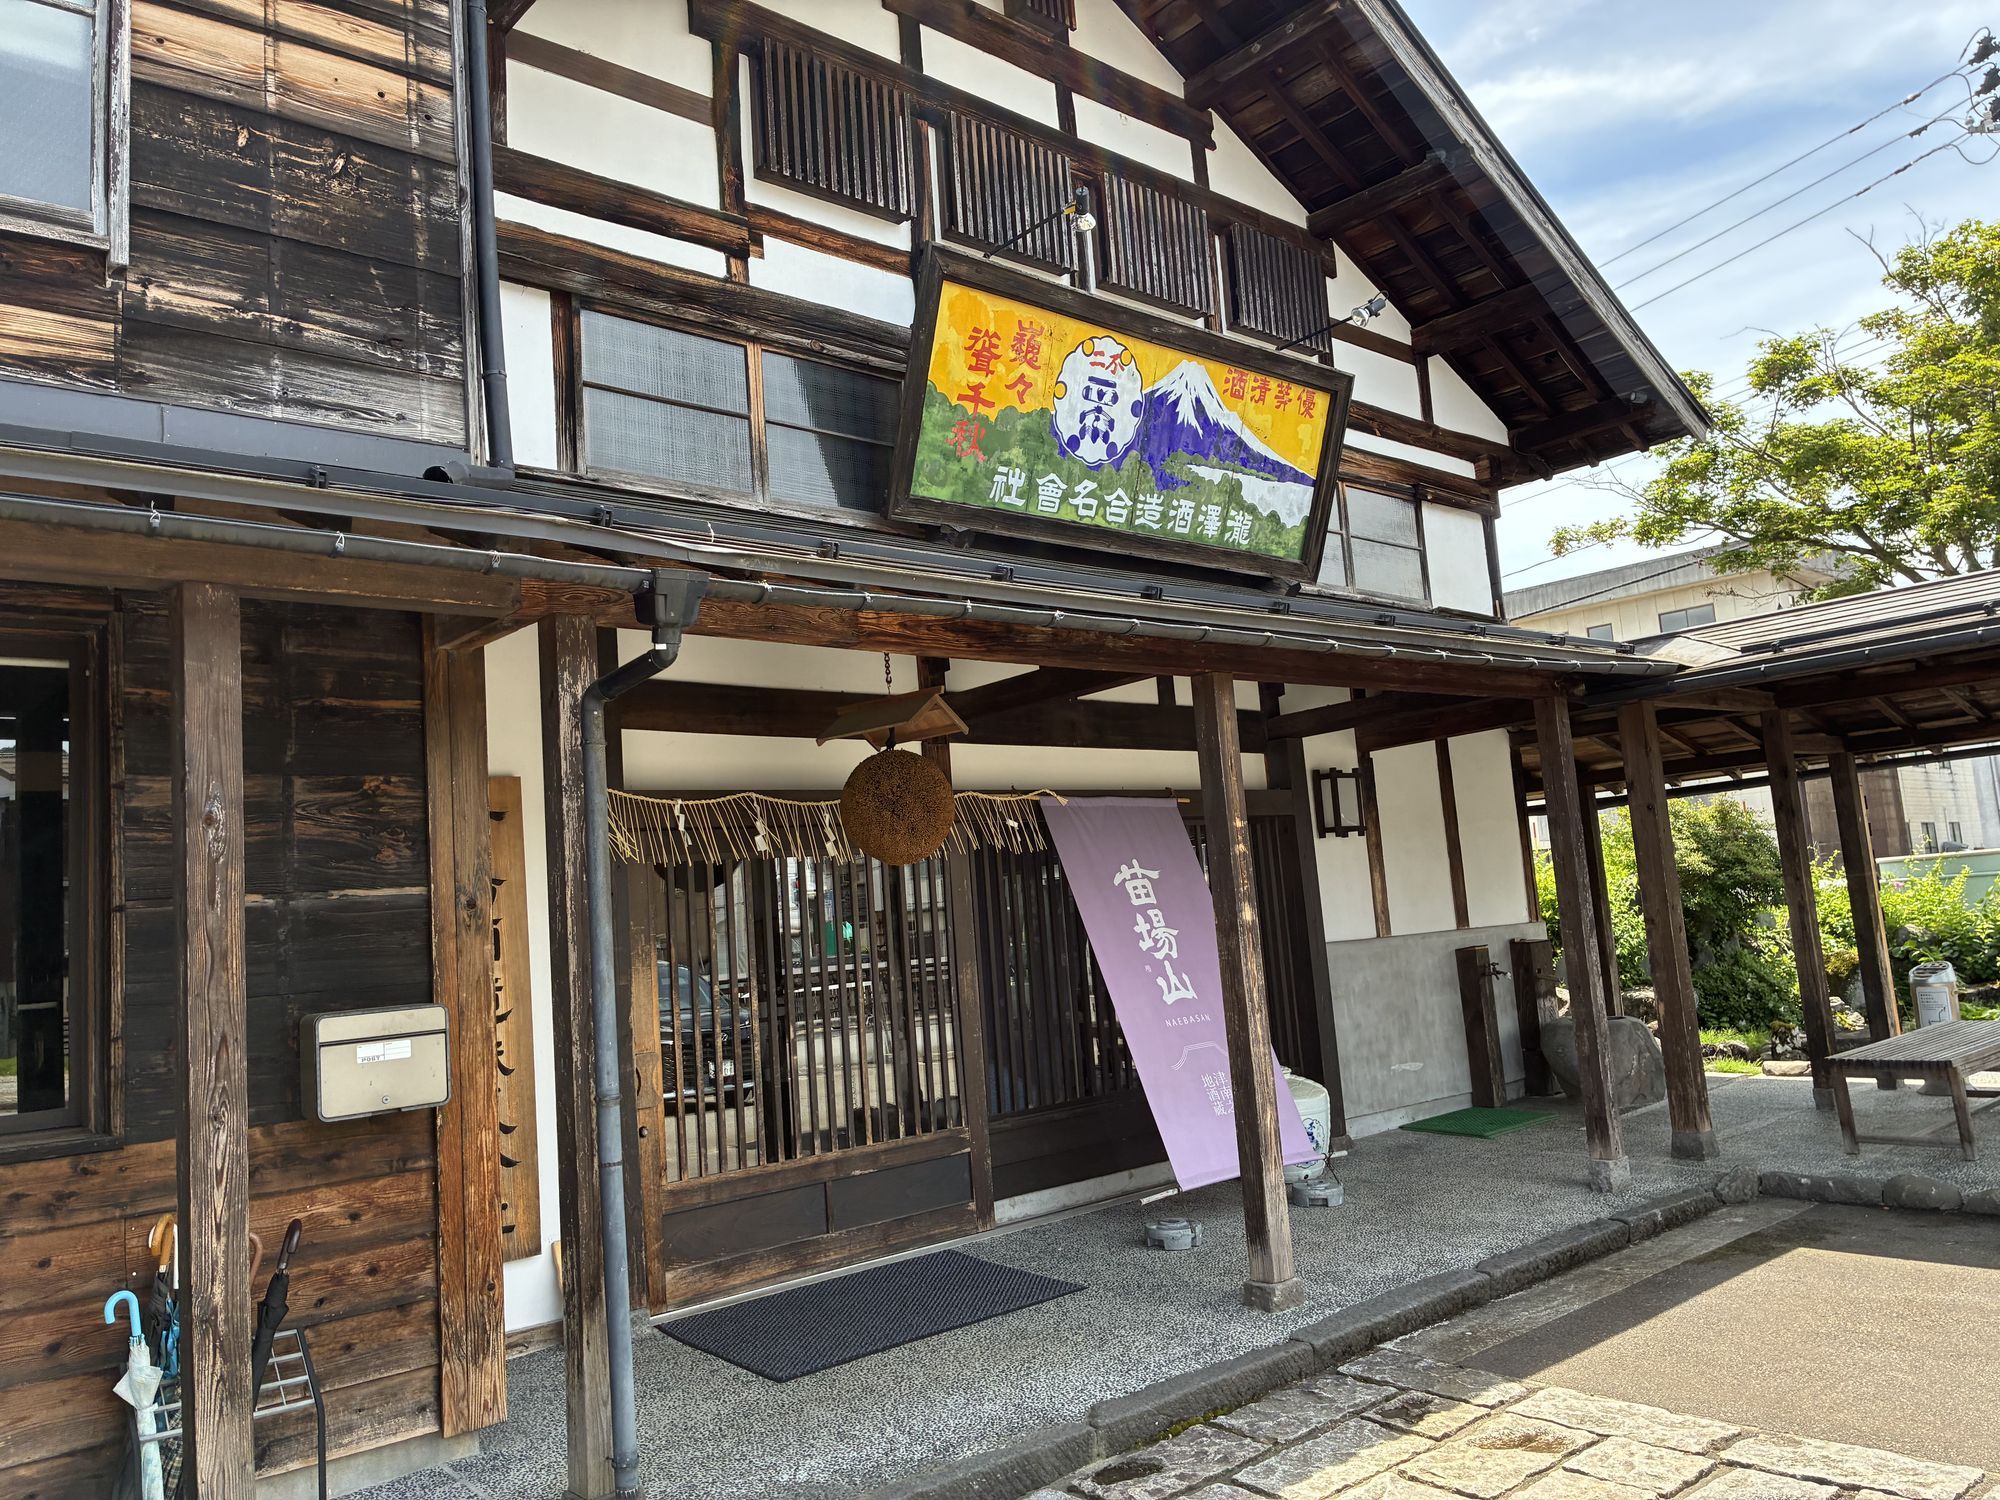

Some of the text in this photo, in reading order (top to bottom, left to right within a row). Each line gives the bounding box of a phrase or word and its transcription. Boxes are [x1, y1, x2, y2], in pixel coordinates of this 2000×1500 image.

[1113, 858, 1198, 1005] 苗場山
[1164, 1012, 1211, 1028] NAEBASAN
